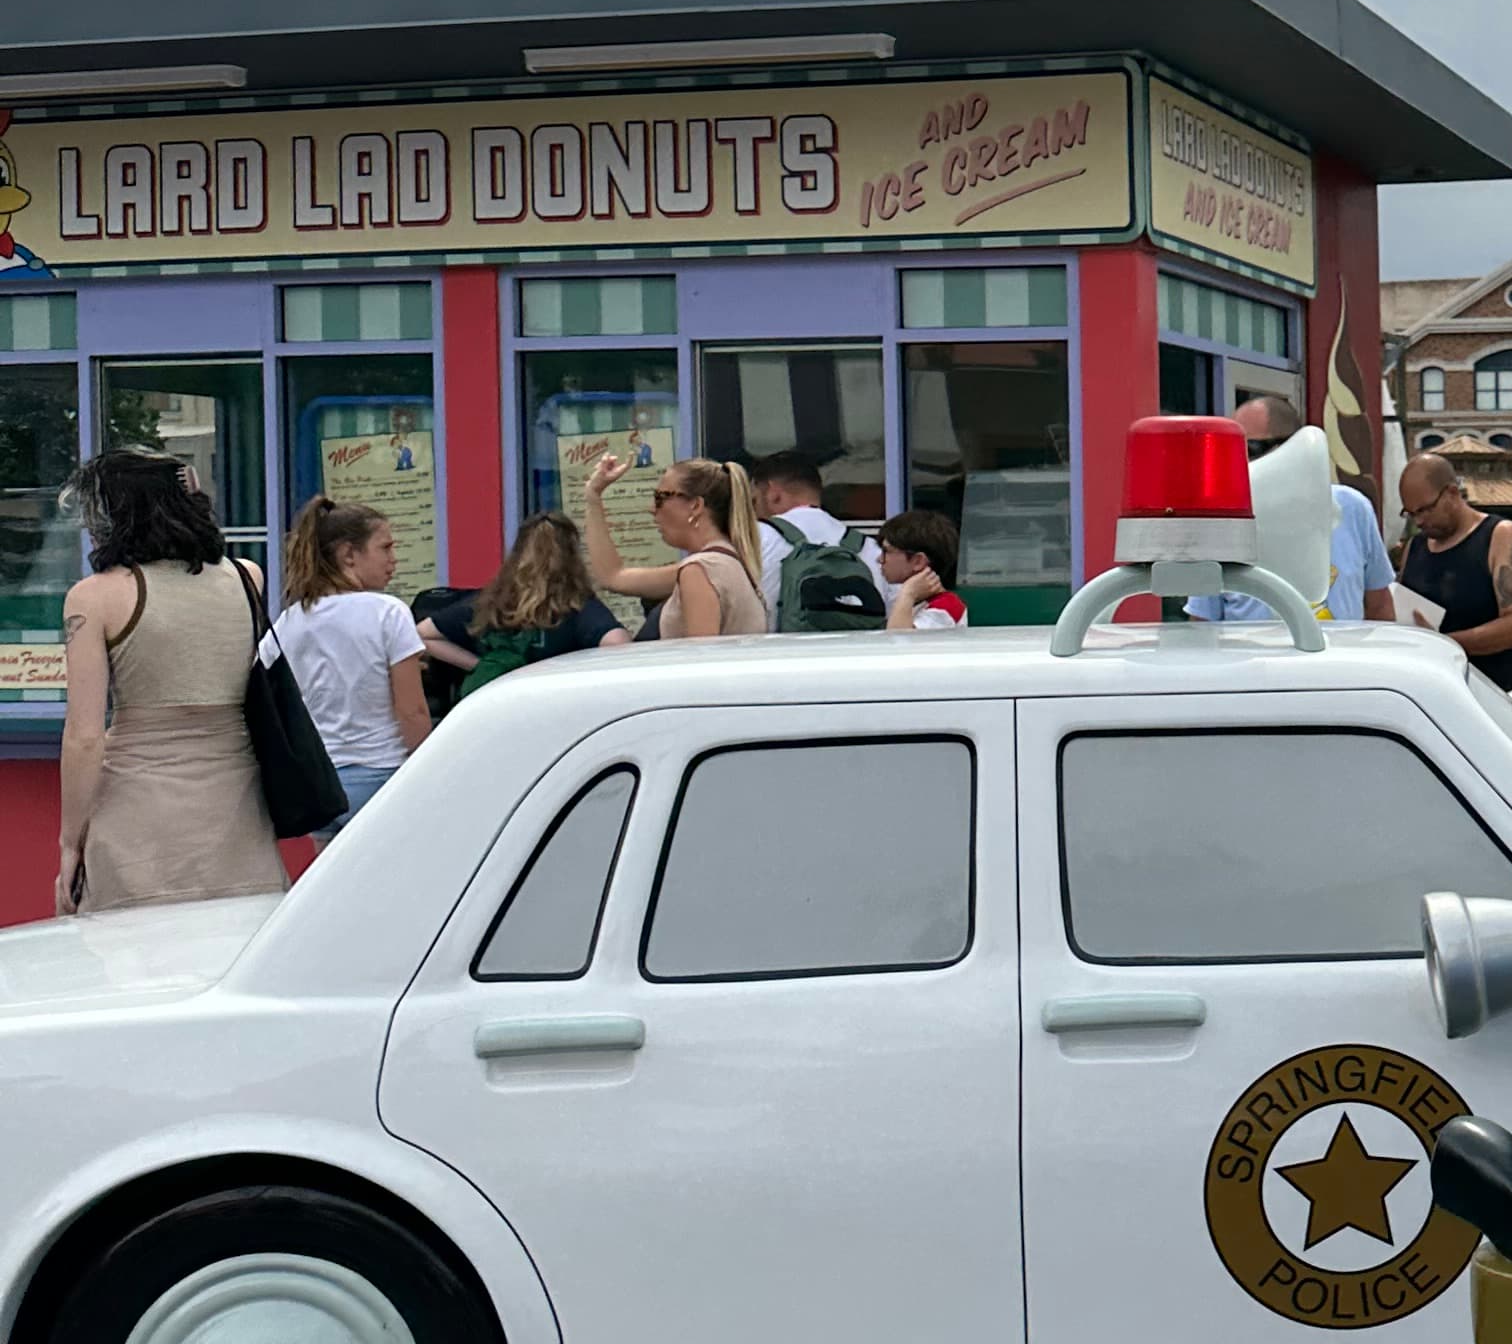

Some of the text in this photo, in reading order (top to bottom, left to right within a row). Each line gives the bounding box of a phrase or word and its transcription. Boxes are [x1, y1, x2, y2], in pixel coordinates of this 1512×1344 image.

[920, 91, 989, 150] AND
[58, 112, 840, 240] LARD LAD DONUTS
[860, 99, 1090, 229] ICE CREAM
[1162, 99, 1305, 217] LARD LAD DONUTS
[1184, 179, 1292, 256] AND ICE CREAM
[328, 441, 371, 468] Menu
[565, 437, 609, 465] Menu
[26, 669, 67, 683] Sunda
[1216, 1055, 1451, 1183] SPRINGFIE
[1258, 1252, 1441, 1319] POLICE
